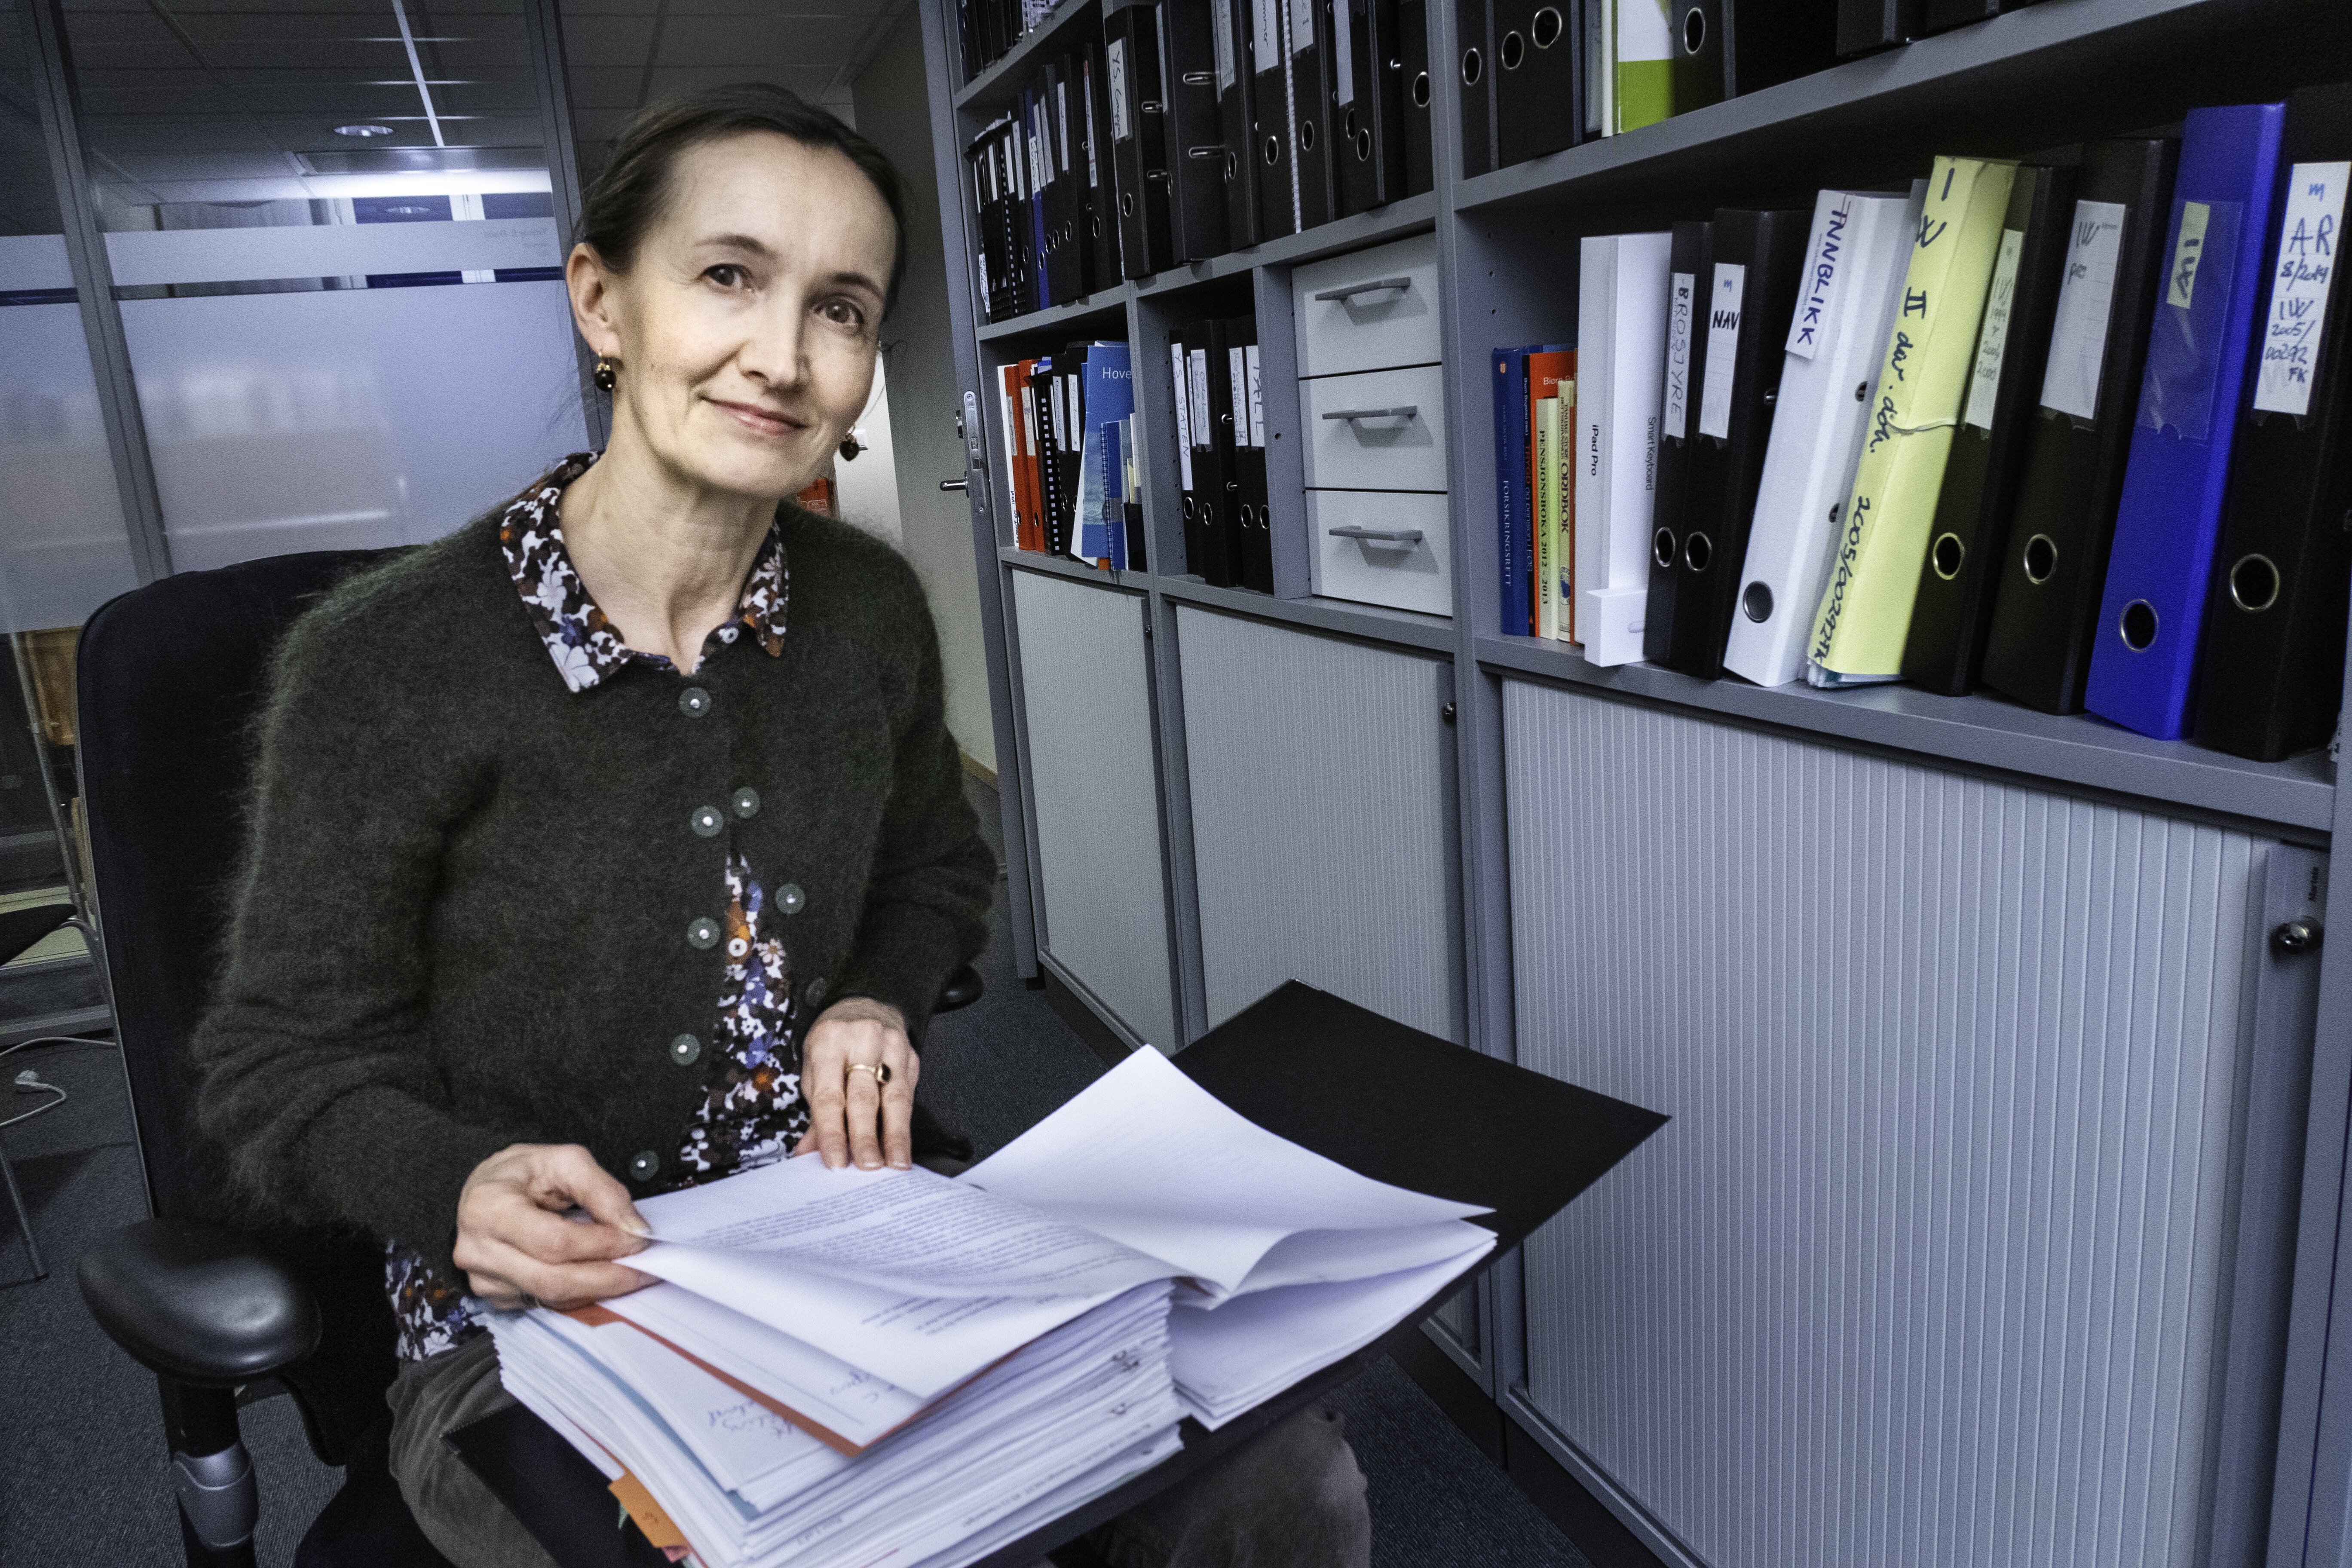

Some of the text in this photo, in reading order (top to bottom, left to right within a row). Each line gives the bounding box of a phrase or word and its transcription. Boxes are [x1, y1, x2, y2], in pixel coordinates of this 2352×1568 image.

[1797, 209, 1847, 346] INNBLIKK
[1712, 309, 1740, 330] NAV
[1102, 367, 1132, 379] Hove
[1670, 287, 1689, 423] BROSJYRE
[1178, 395, 1189, 458] STATEN
[1591, 424, 1599, 452] iPad
[1645, 417, 1656, 490] Smart Keyboard
[1503, 480, 1512, 587] FORSIKRINGSRETT
